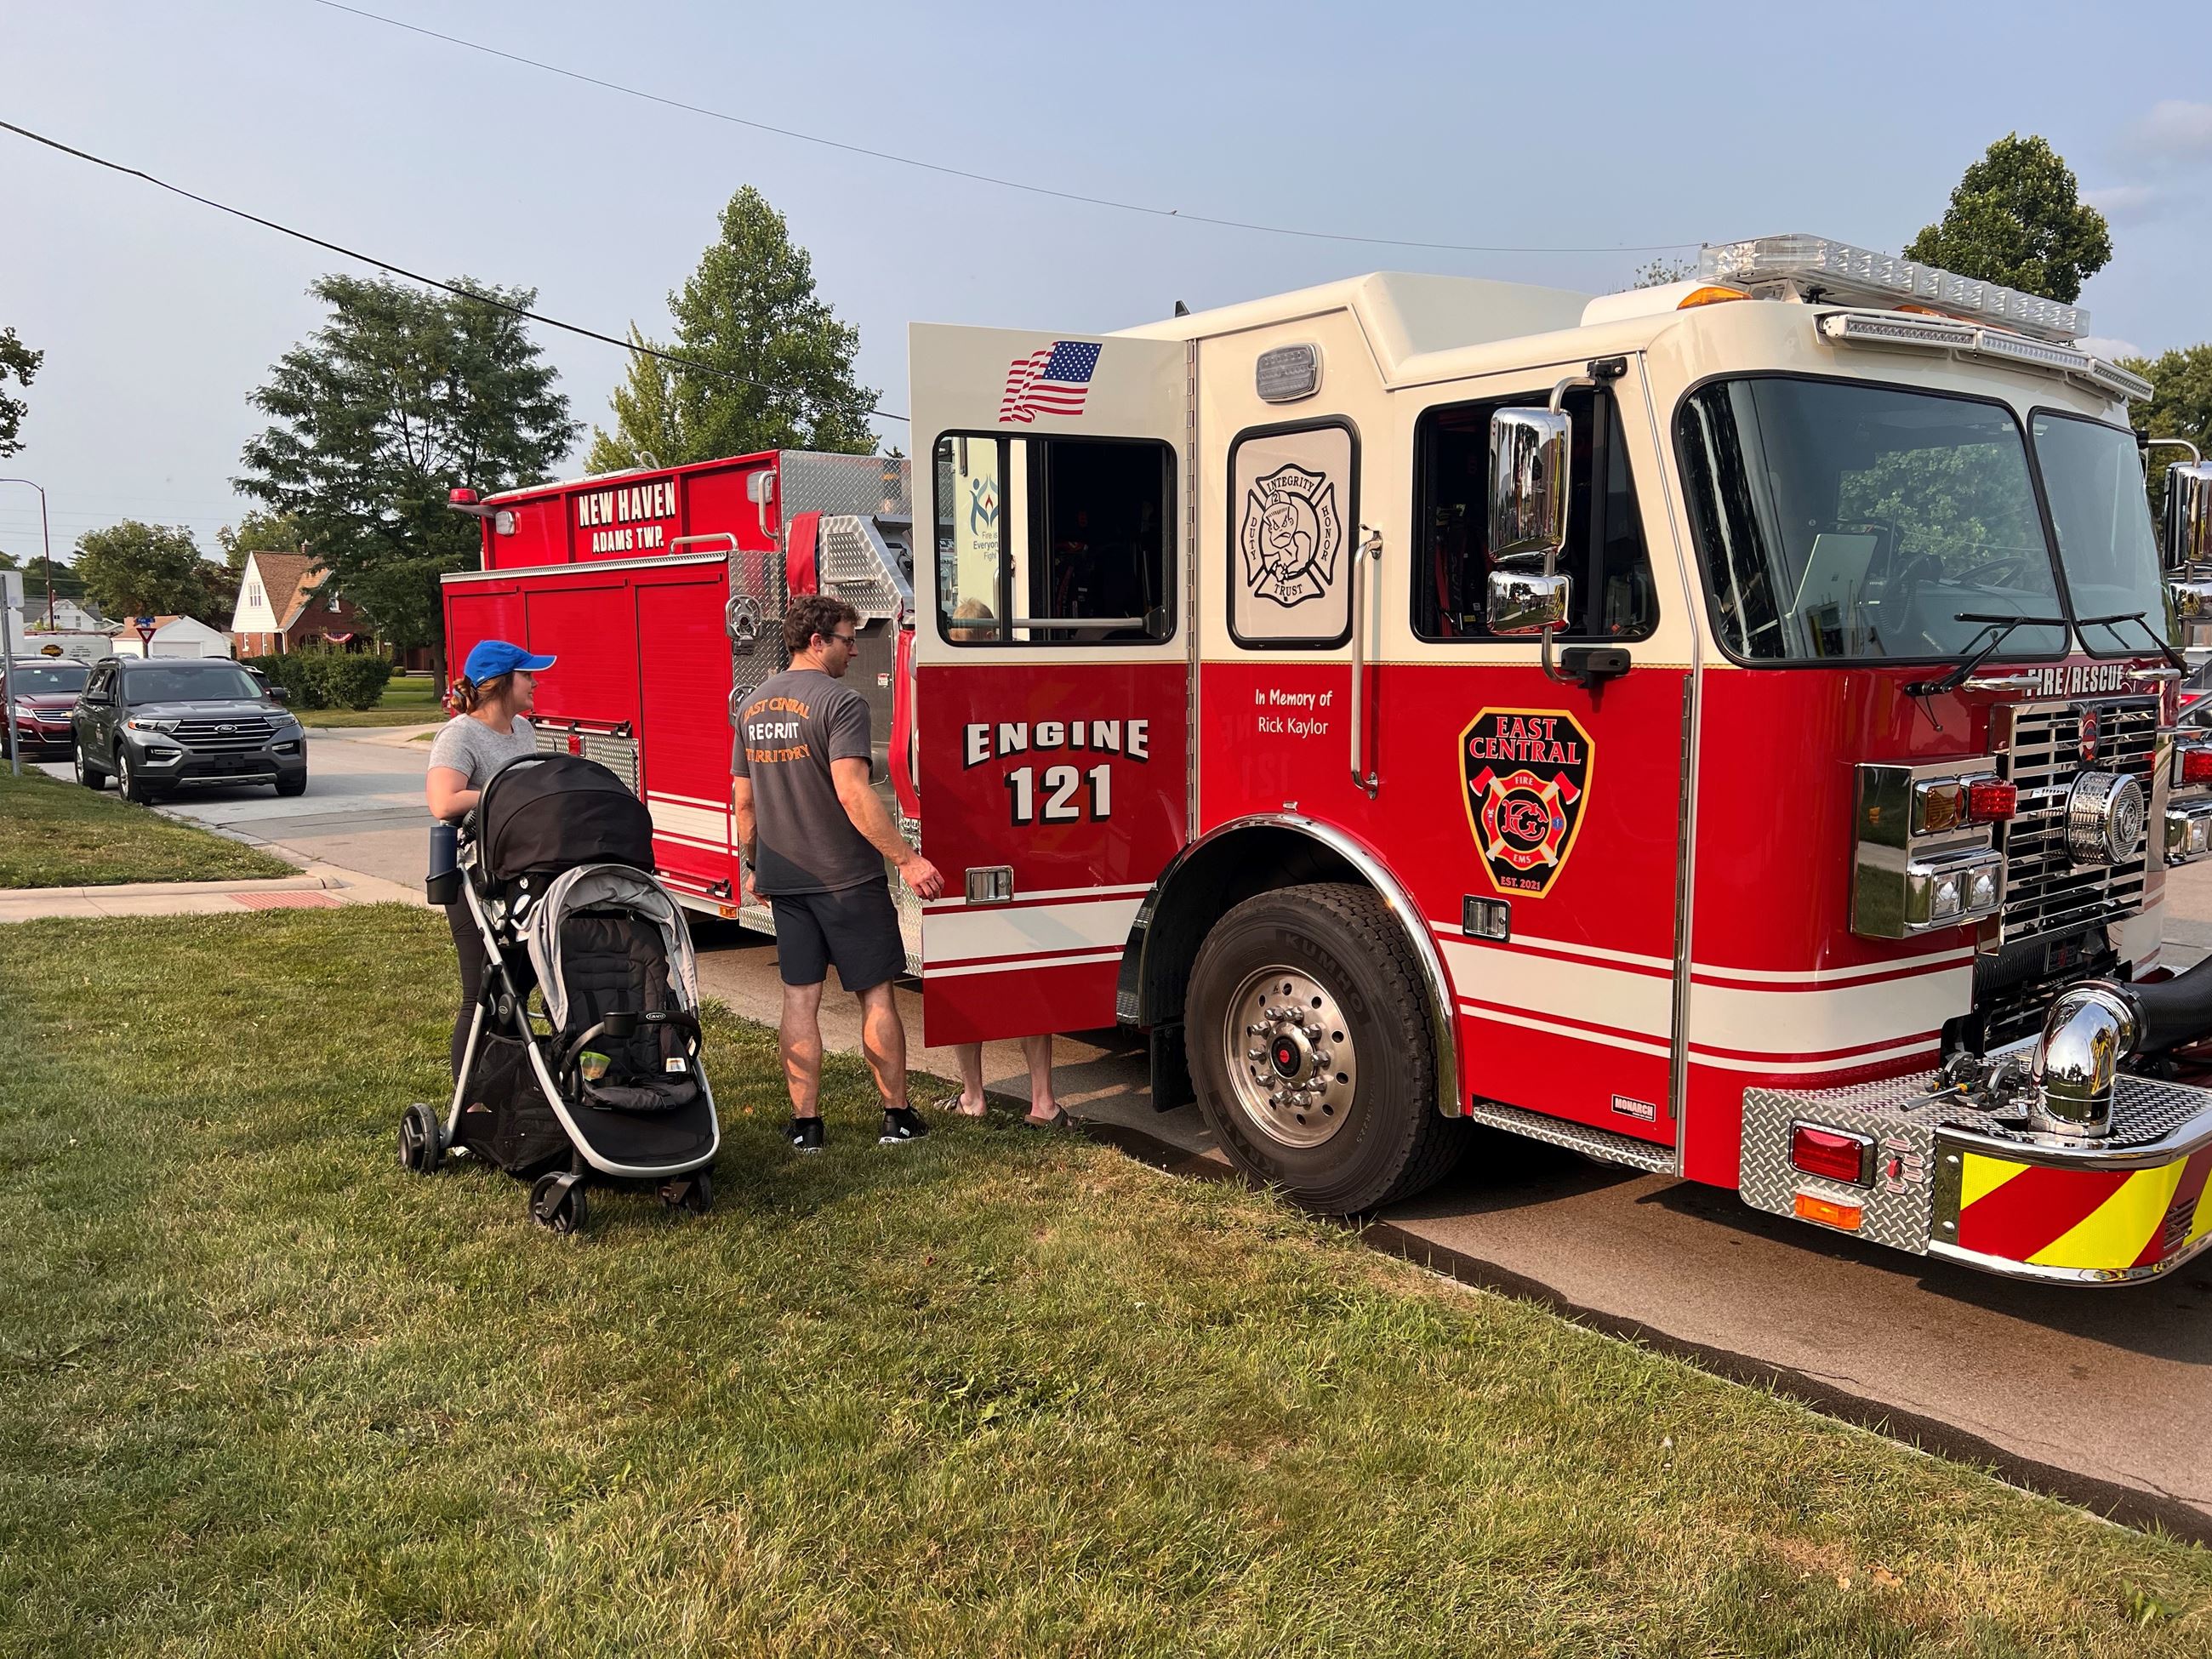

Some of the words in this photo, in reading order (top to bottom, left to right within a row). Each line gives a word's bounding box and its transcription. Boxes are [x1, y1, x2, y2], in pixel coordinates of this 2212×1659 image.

[1267, 476, 1314, 493] INTEGRITY
[579, 492, 613, 527] NEW
[618, 482, 676, 522] HAVEN
[592, 529, 633, 553] ADAMS
[636, 526, 664, 549] TWP.
[1249, 517, 1257, 561] DUTY
[1321, 505, 1331, 562] HONOR
[973, 540, 999, 550] Everyon
[1274, 584, 1303, 596] TRUST
[1256, 688, 1265, 705] In
[1269, 689, 1315, 710] Memory
[1320, 690, 1332, 706] of
[1258, 716, 1283, 733] Rick
[1287, 717, 1328, 738] Kaylor
[1496, 716, 1557, 740] EAST
[745, 744, 811, 763] TRRITORY
[965, 719, 1149, 769] ENGINE
[1469, 737, 1582, 765] CENTRAL
[1514, 776, 1534, 786] FIRE
[1006, 764, 1111, 824] 121
[1513, 853, 1531, 864] EMS
[1500, 876, 1518, 888] EST.
[1519, 879, 1541, 890] 2021
[1286, 933, 1363, 1012] KUMHO
[1615, 1097, 1653, 1117] MONARCH
